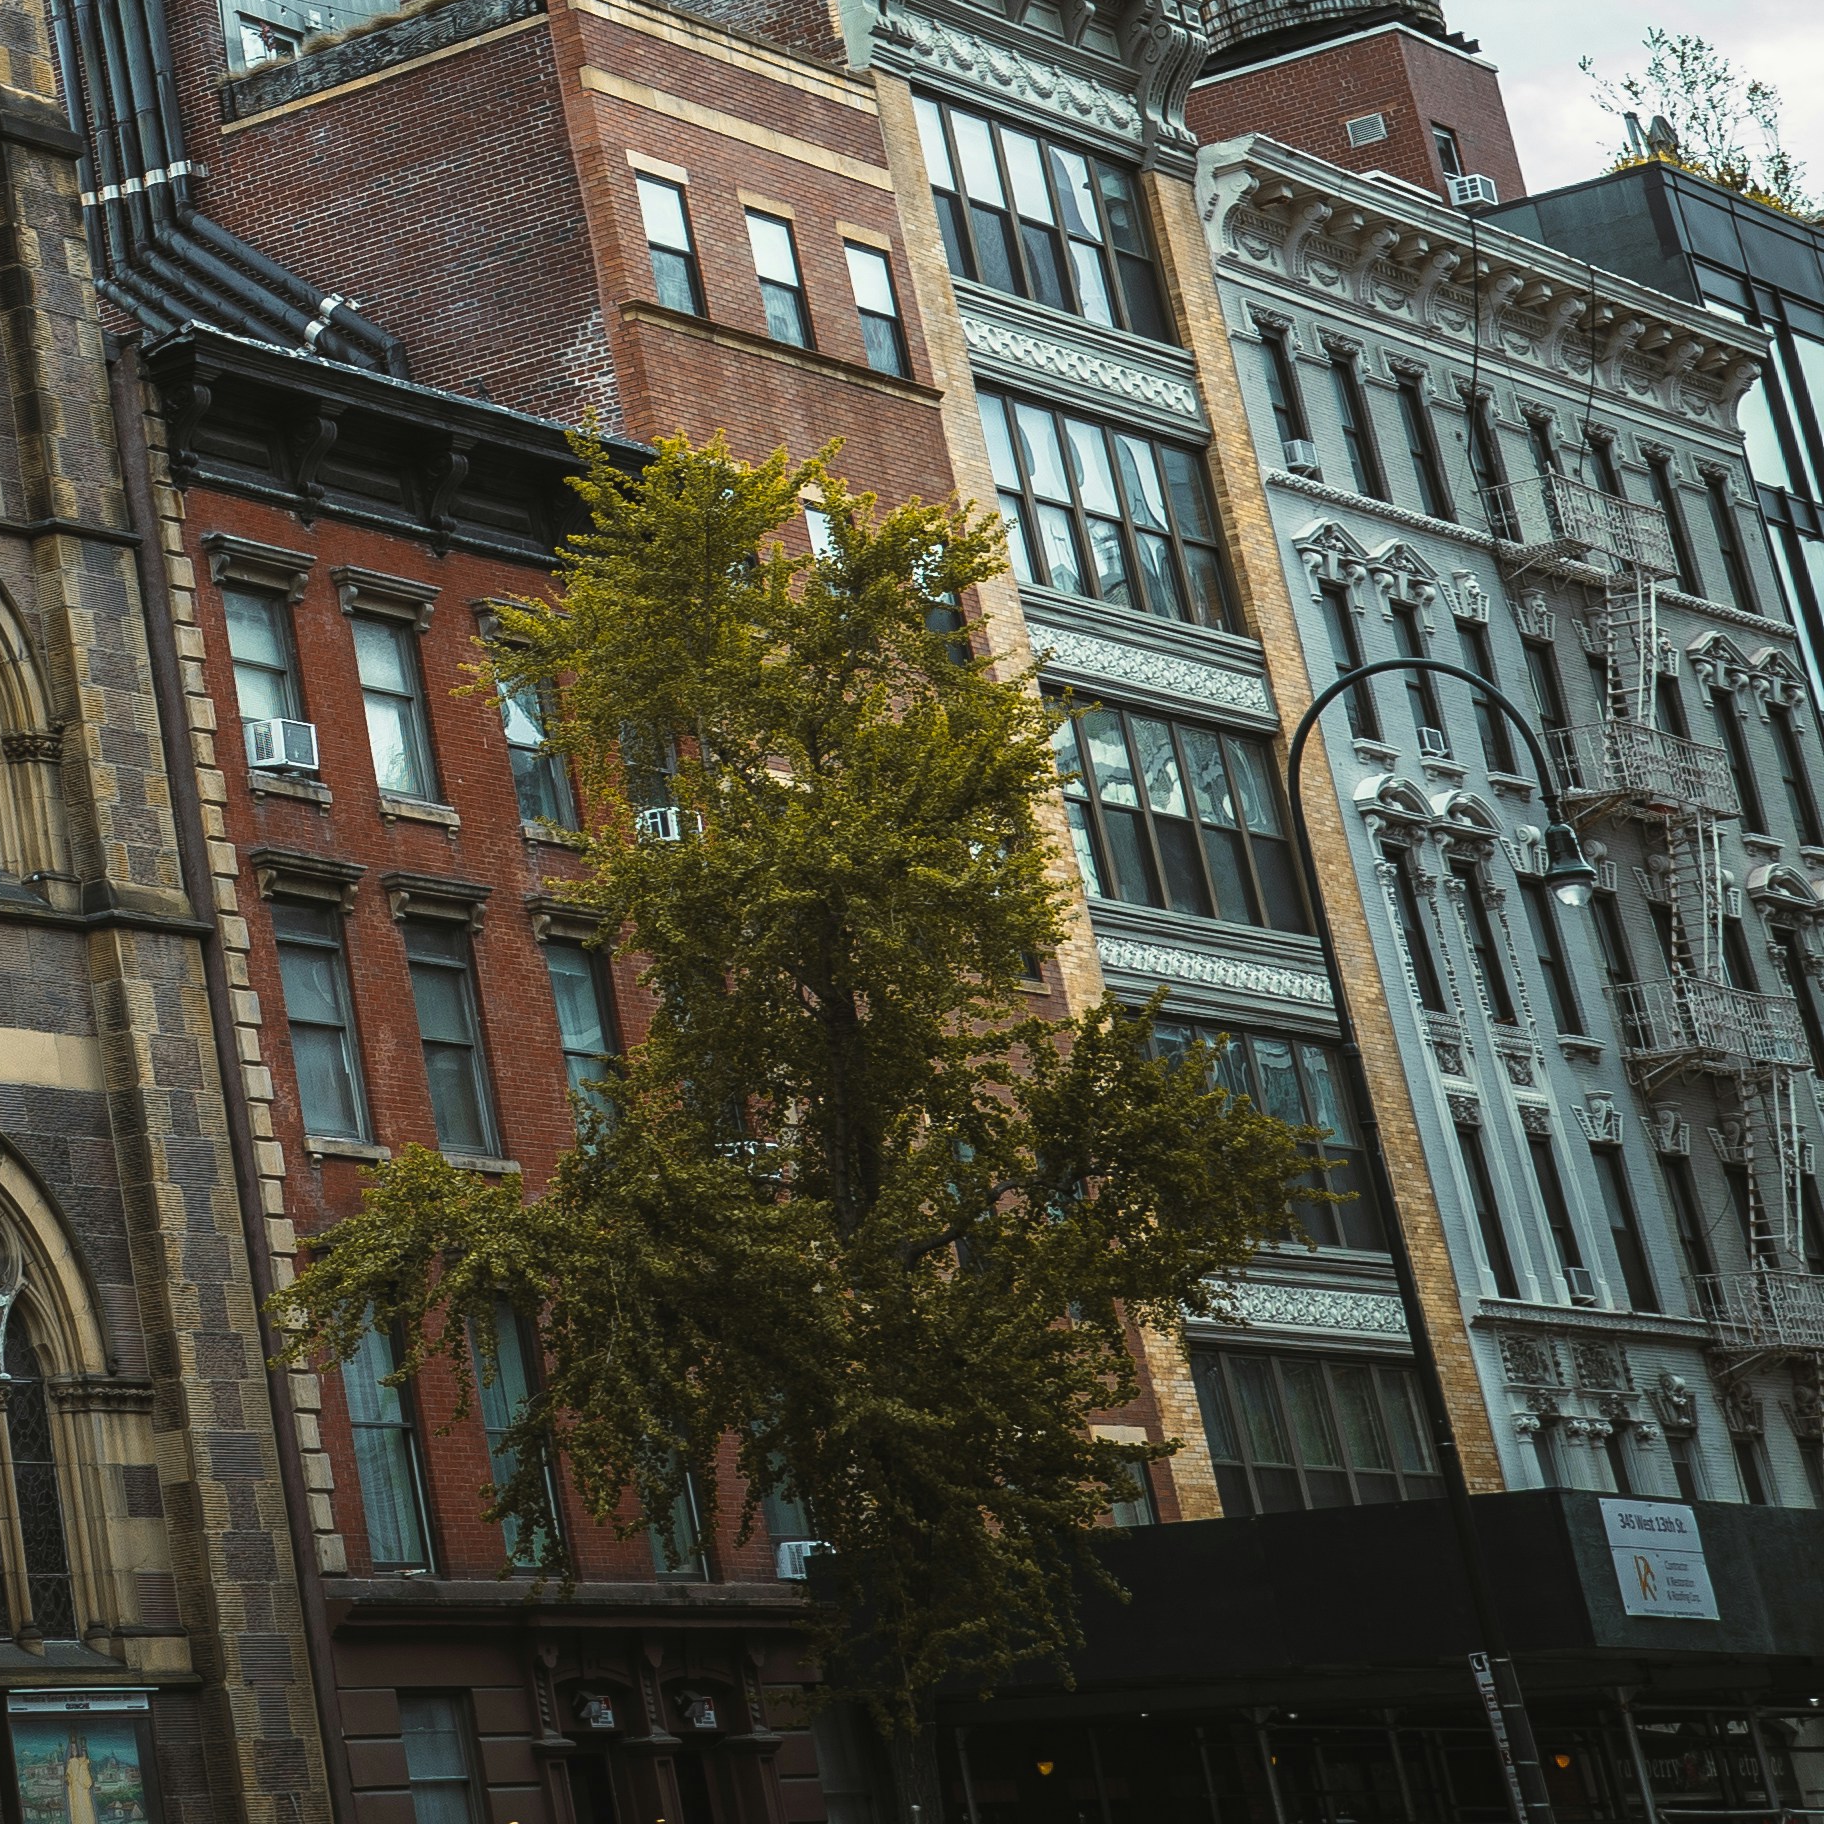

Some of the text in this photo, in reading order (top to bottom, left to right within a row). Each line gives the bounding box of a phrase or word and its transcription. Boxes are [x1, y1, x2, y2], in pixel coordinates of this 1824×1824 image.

[1618, 1513, 1687, 1533] 345 West 13th St.
